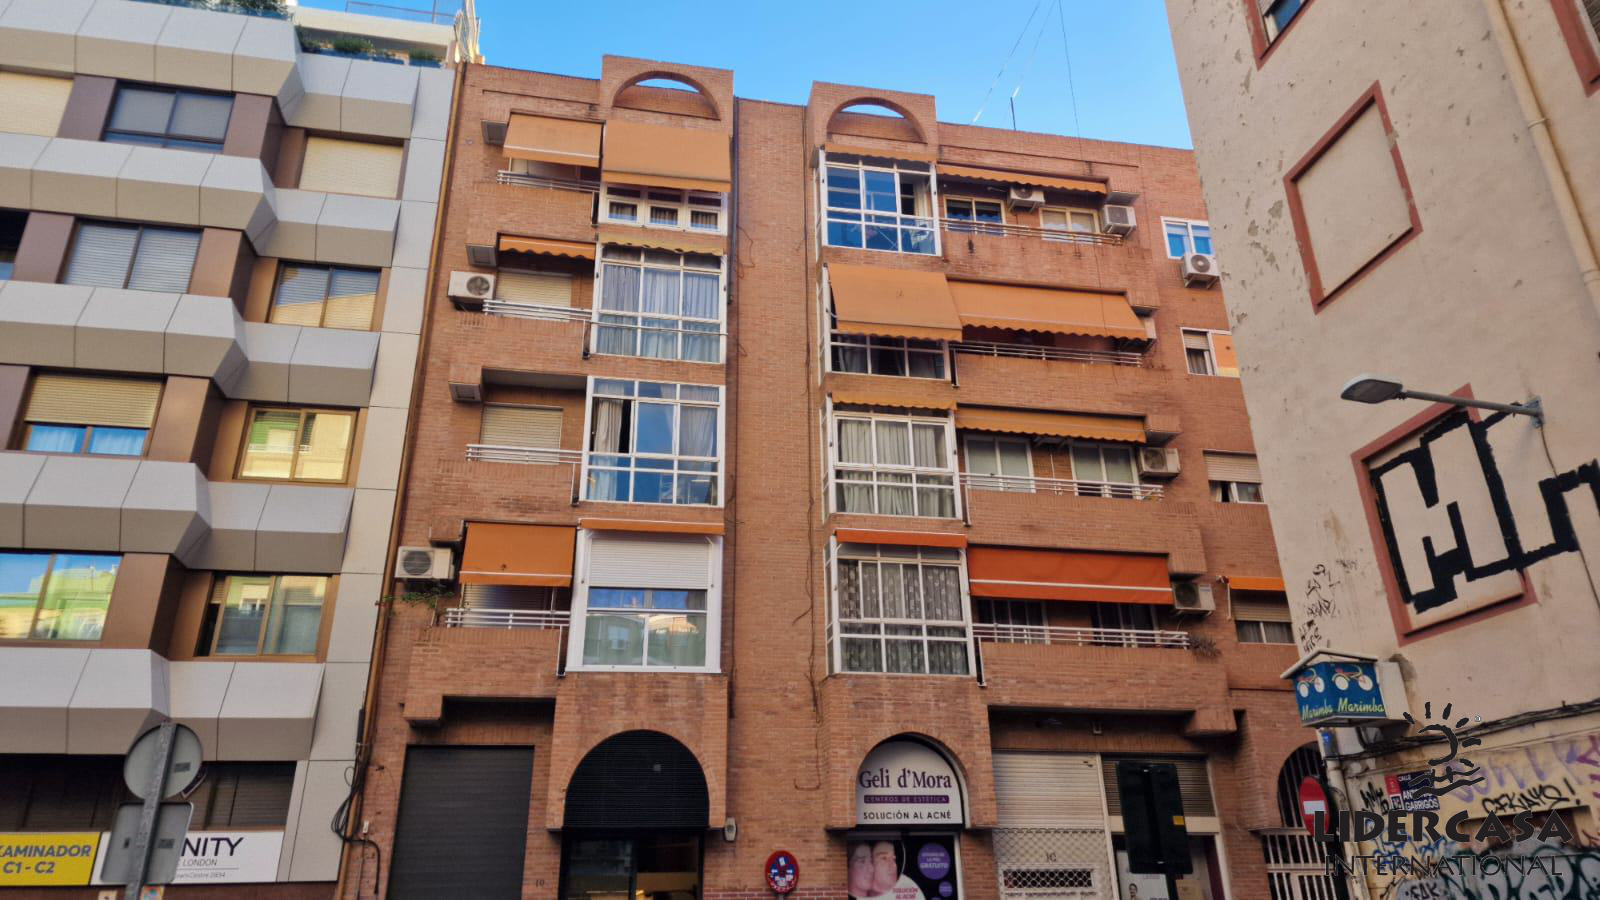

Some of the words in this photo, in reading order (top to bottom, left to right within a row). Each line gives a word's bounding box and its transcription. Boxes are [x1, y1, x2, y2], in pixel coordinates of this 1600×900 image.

[1302, 699, 1333, 720] Marimba
[1338, 697, 1385, 713] Marimba
[859, 768, 890, 788] Geli
[863, 810, 909, 819] SOLUCIÓN
[913, 811, 923, 819] AL
[927, 810, 952, 819] ACNÉ
[181, 837, 244, 856] NITY
[3, 861, 22, 874] C1
[34, 861, 55, 874] C2
[183, 858, 218, 867] LONDON
